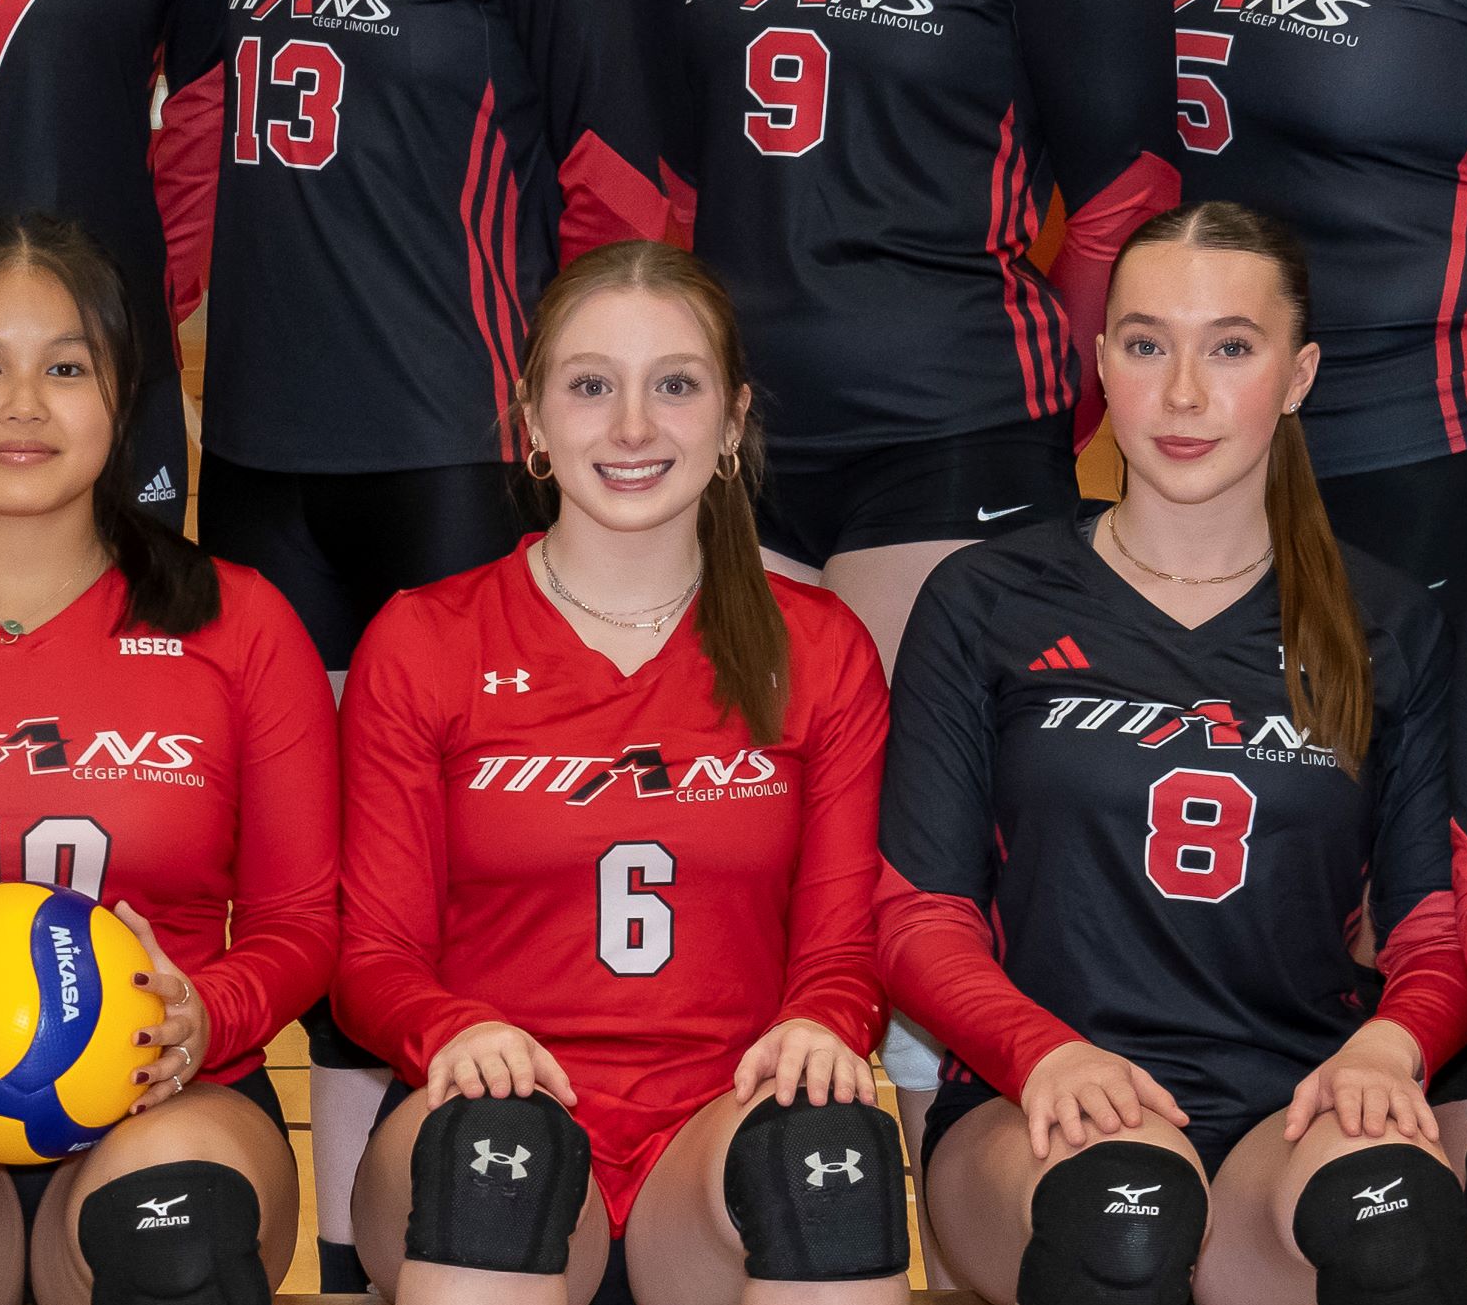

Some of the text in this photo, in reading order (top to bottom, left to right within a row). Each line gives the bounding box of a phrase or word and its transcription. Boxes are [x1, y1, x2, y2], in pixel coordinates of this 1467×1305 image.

[311, 15, 401, 38] CÉGEP LIMOILOU
[825, 3, 944, 37] CÉGEP LIMOILOU
[1238, 8, 1360, 48] CÉGEP LIMOILOU
[233, 35, 348, 171] 13
[743, 26, 831, 159] 9
[1175, 27, 1235, 156] 5
[137, 483, 178, 503] adidas
[119, 636, 185, 658] RSEQ
[71, 763, 206, 789] CÉGEP LIMOILOU
[468, 742, 778, 807] TITANS
[1245, 745, 1338, 768] CÉGEP LIMO
[675, 781, 788, 803] CÉGEP LIMOILOU
[1144, 766, 1258, 904] 8
[594, 838, 678, 978] 6
[49, 925, 81, 1024] MIKASA
